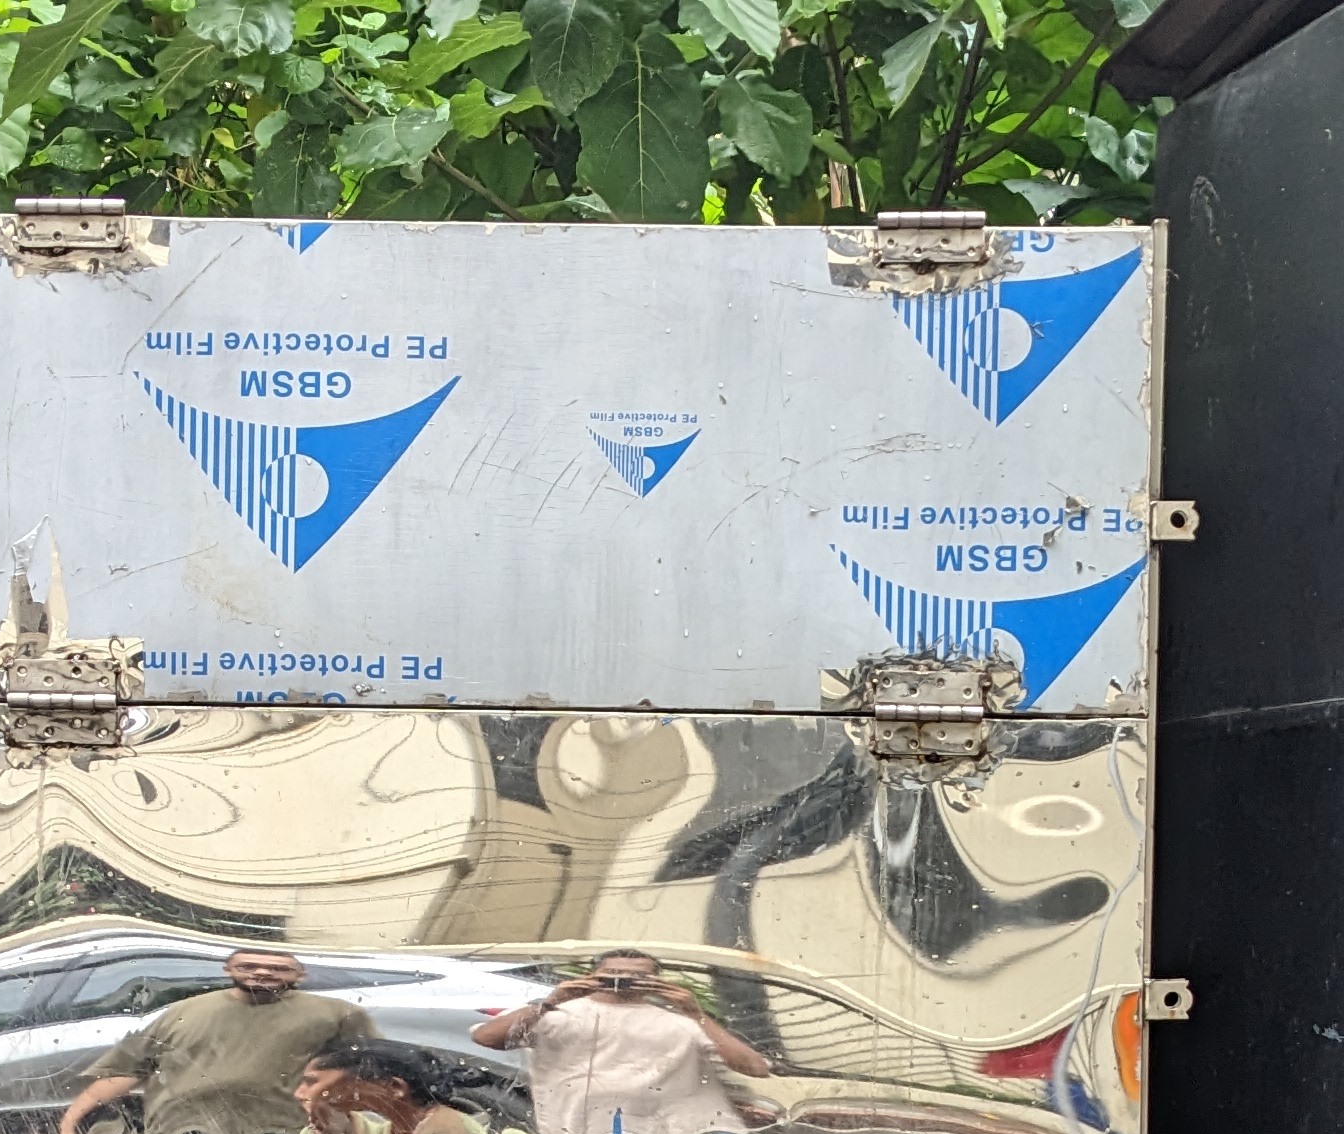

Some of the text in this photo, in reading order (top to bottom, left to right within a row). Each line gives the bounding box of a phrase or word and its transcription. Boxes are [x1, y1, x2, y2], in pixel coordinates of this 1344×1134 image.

[146, 331, 447, 359] PE Protective Film
[240, 370, 351, 398] GBSM
[624, 426, 663, 437] GBSM
[842, 505, 909, 530] Film
[920, 506, 1086, 532] Protective
[936, 545, 1048, 572] GBSM
[144, 651, 442, 680] PE Protective Film
